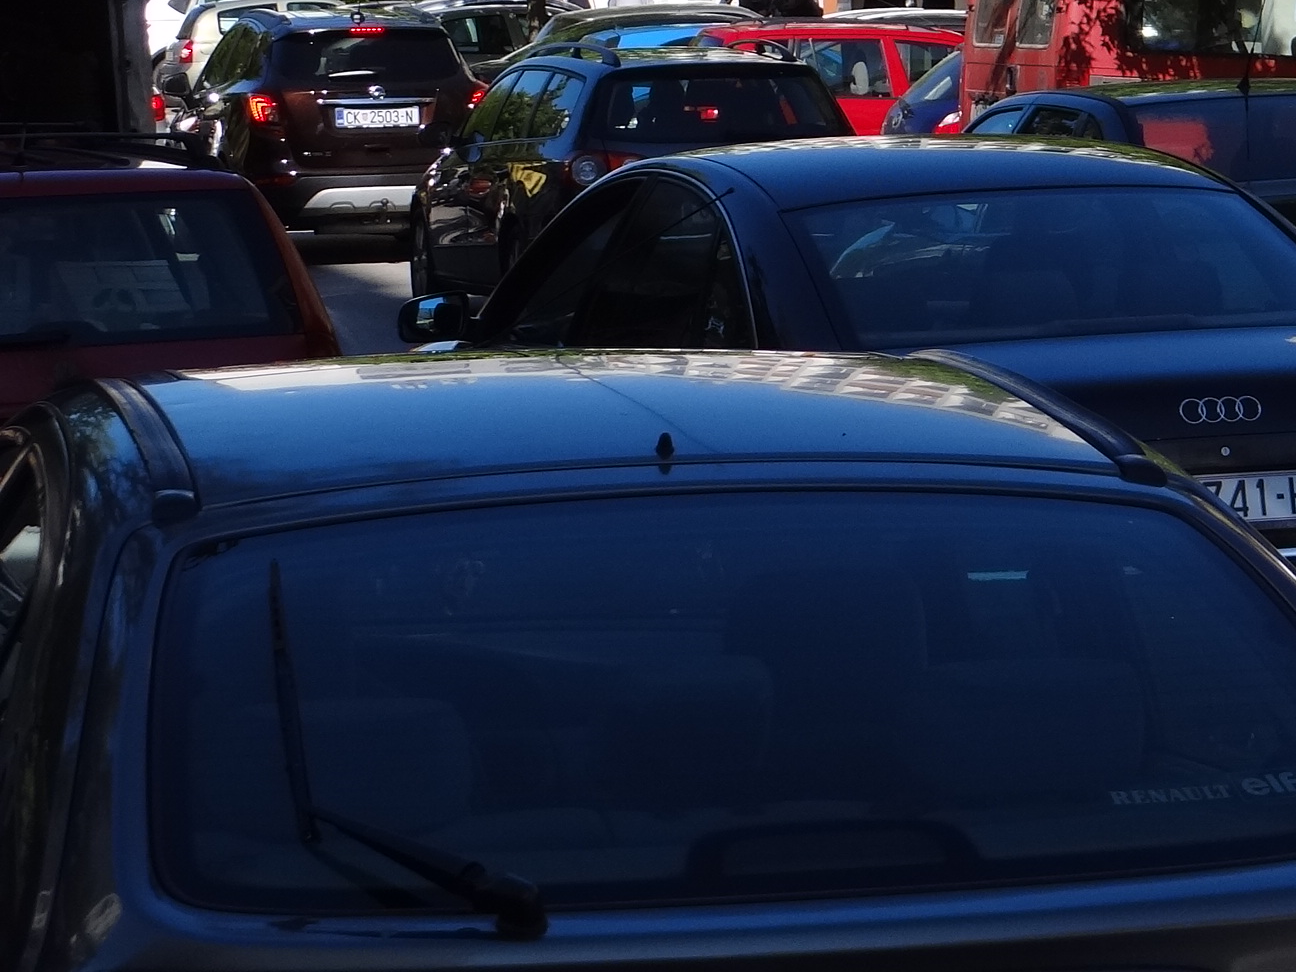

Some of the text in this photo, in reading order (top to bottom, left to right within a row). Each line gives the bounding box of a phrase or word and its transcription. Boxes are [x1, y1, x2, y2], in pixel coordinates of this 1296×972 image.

[346, 109, 413, 124] CK 2503-N
[1109, 784, 1231, 805] RENAULT
